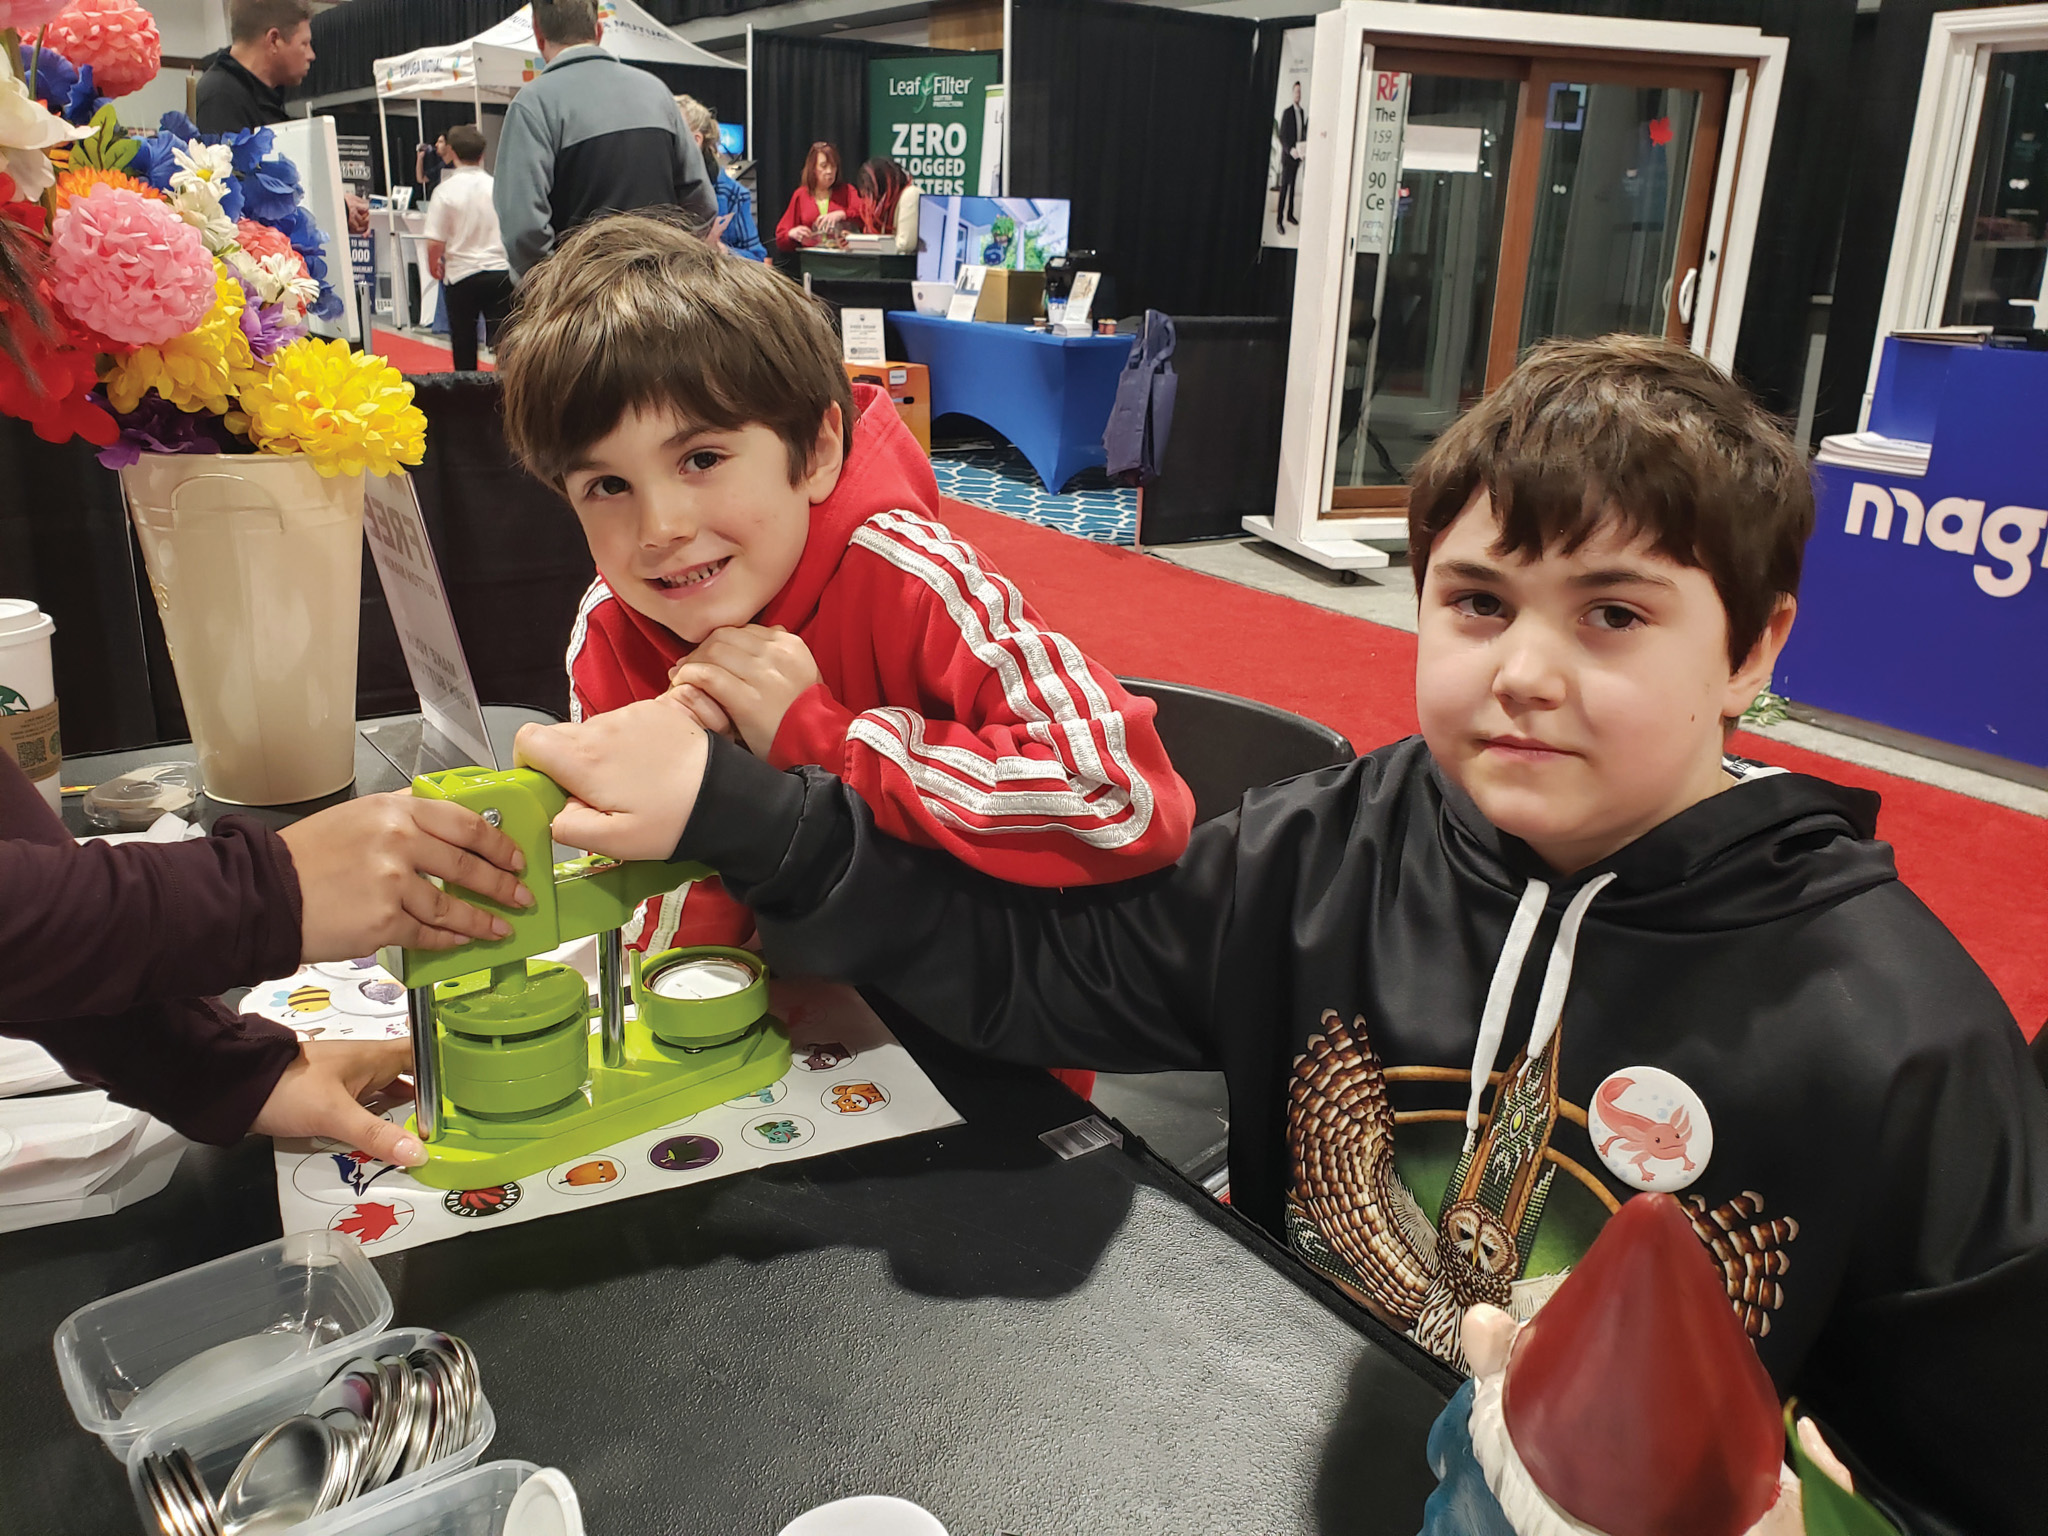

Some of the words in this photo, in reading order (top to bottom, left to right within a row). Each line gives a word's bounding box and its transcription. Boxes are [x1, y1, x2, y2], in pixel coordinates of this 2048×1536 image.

[889, 76, 921, 96] Leaf
[933, 75, 971, 95] Filter
[1375, 107, 1396, 122] The
[891, 122, 967, 156] ZERO
[893, 157, 966, 176] LOGGED
[912, 179, 965, 195] TTERS
[1844, 481, 2048, 598] mag
